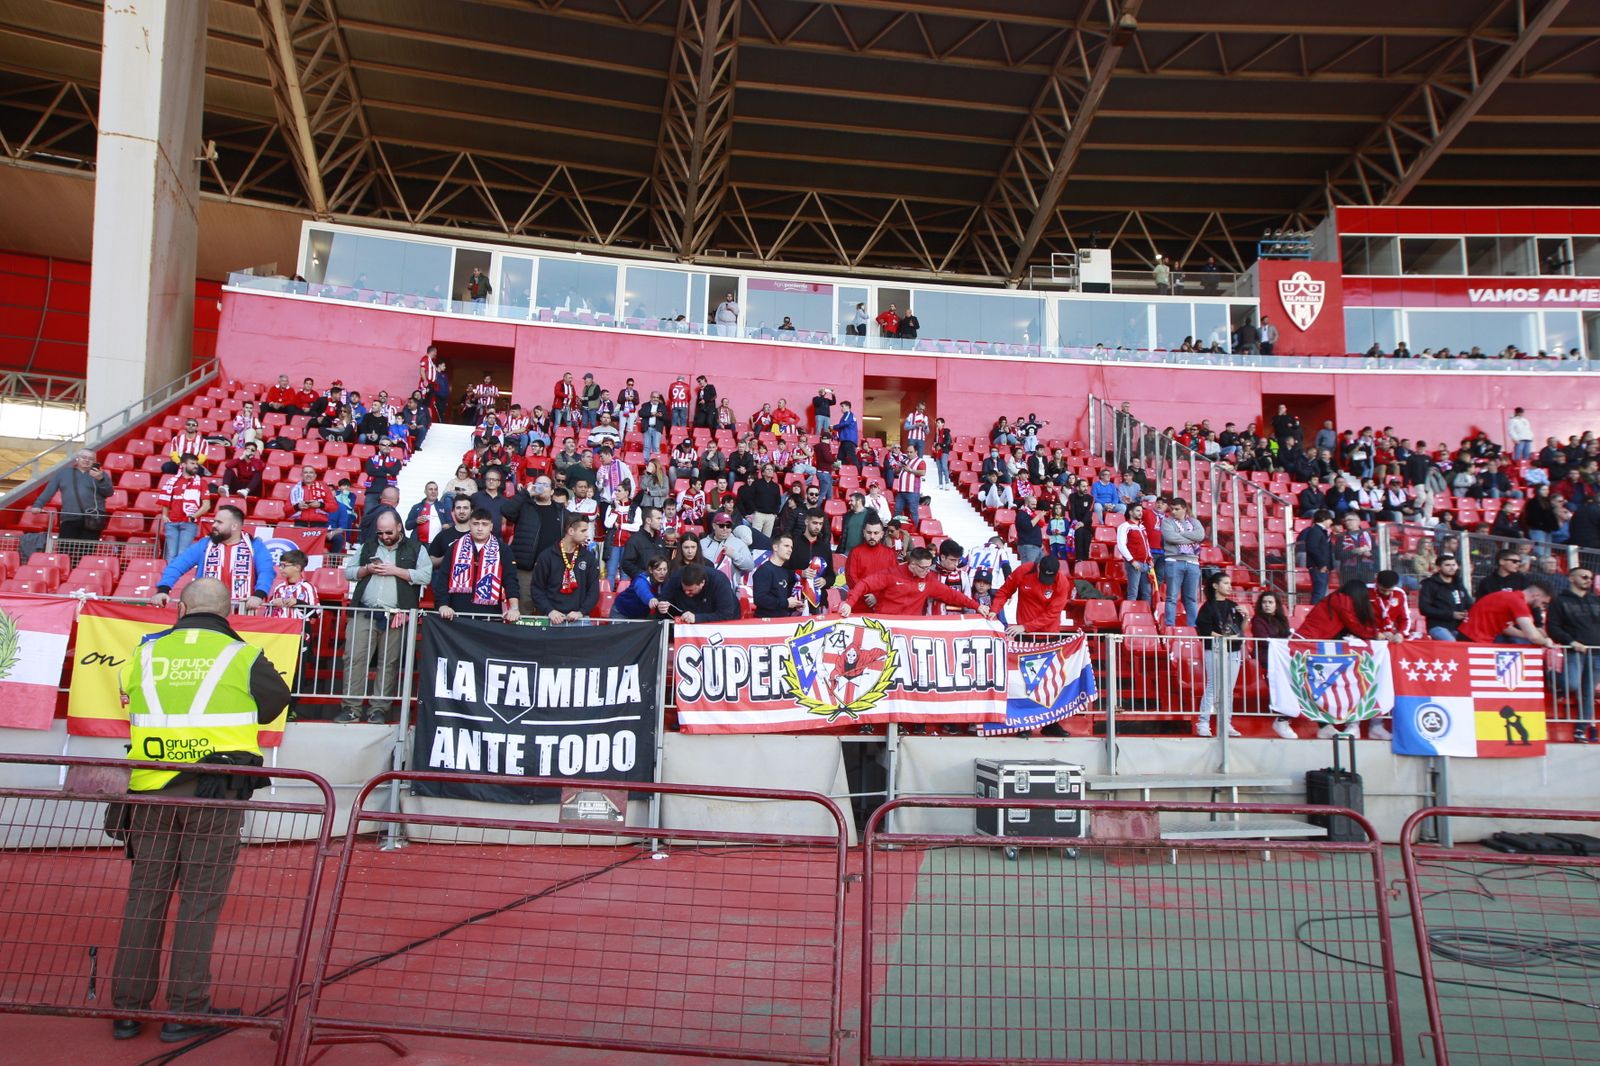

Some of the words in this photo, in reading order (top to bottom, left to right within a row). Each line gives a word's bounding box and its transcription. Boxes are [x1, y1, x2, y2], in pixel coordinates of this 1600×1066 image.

[1284, 283, 1295, 292] U
[1309, 284, 1320, 292] D
[1468, 288, 1540, 302] VAMOS
[1543, 288, 1600, 302] ALME
[672, 387, 686, 400] 96
[171, 657, 217, 671] grupo
[676, 632, 797, 702] SÚPER
[887, 635, 1006, 692] ATLETI
[434, 656, 477, 703] LA
[486, 663, 642, 708] FAMILIA
[1005, 716, 1022, 727] UN
[1023, 691, 1087, 724] SENTIMIENTO
[165, 738, 209, 750] grupo
[429, 726, 526, 776] ANTE
[535, 729, 637, 776] TODO
